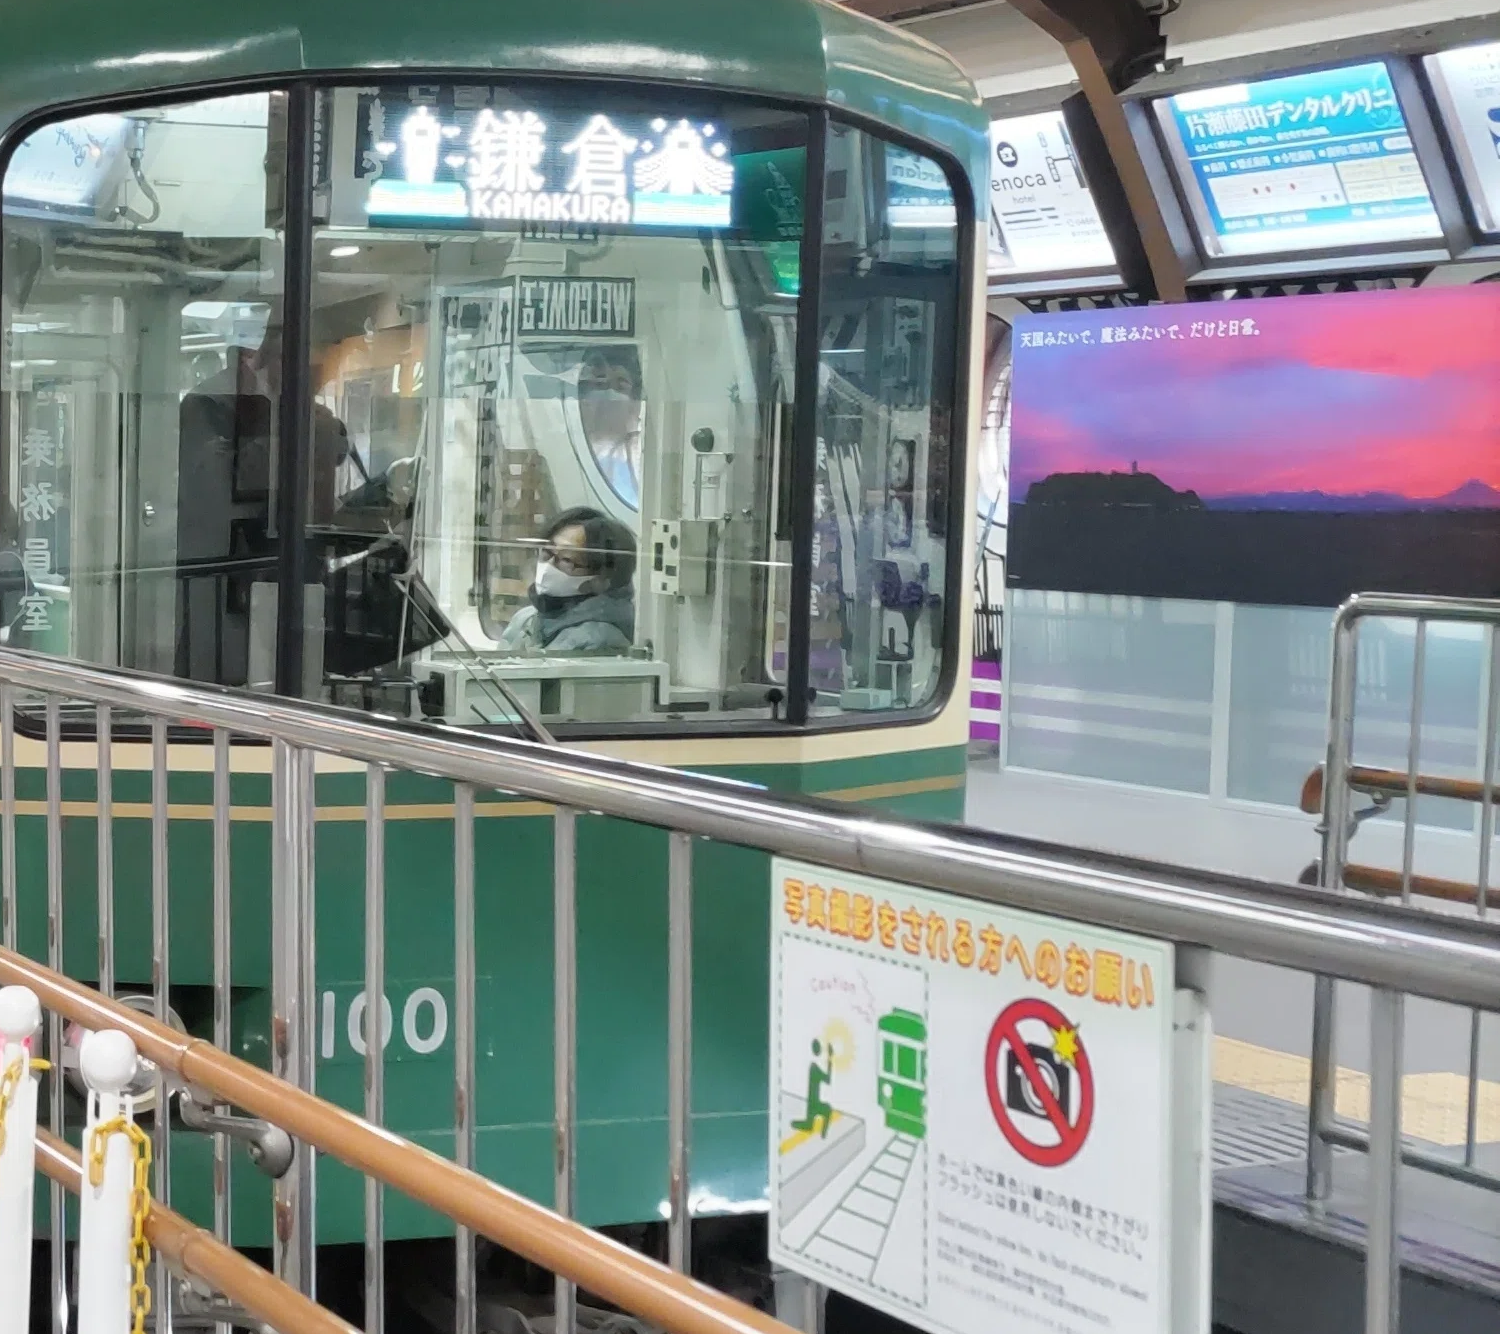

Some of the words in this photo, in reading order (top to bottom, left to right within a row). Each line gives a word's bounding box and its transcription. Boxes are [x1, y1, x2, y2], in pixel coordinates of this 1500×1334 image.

[467, 108, 639, 196] 鎌倉
[471, 190, 632, 223] KAMAKURA
[783, 877, 1155, 1010] 写真撮影をされる方へのお願い
